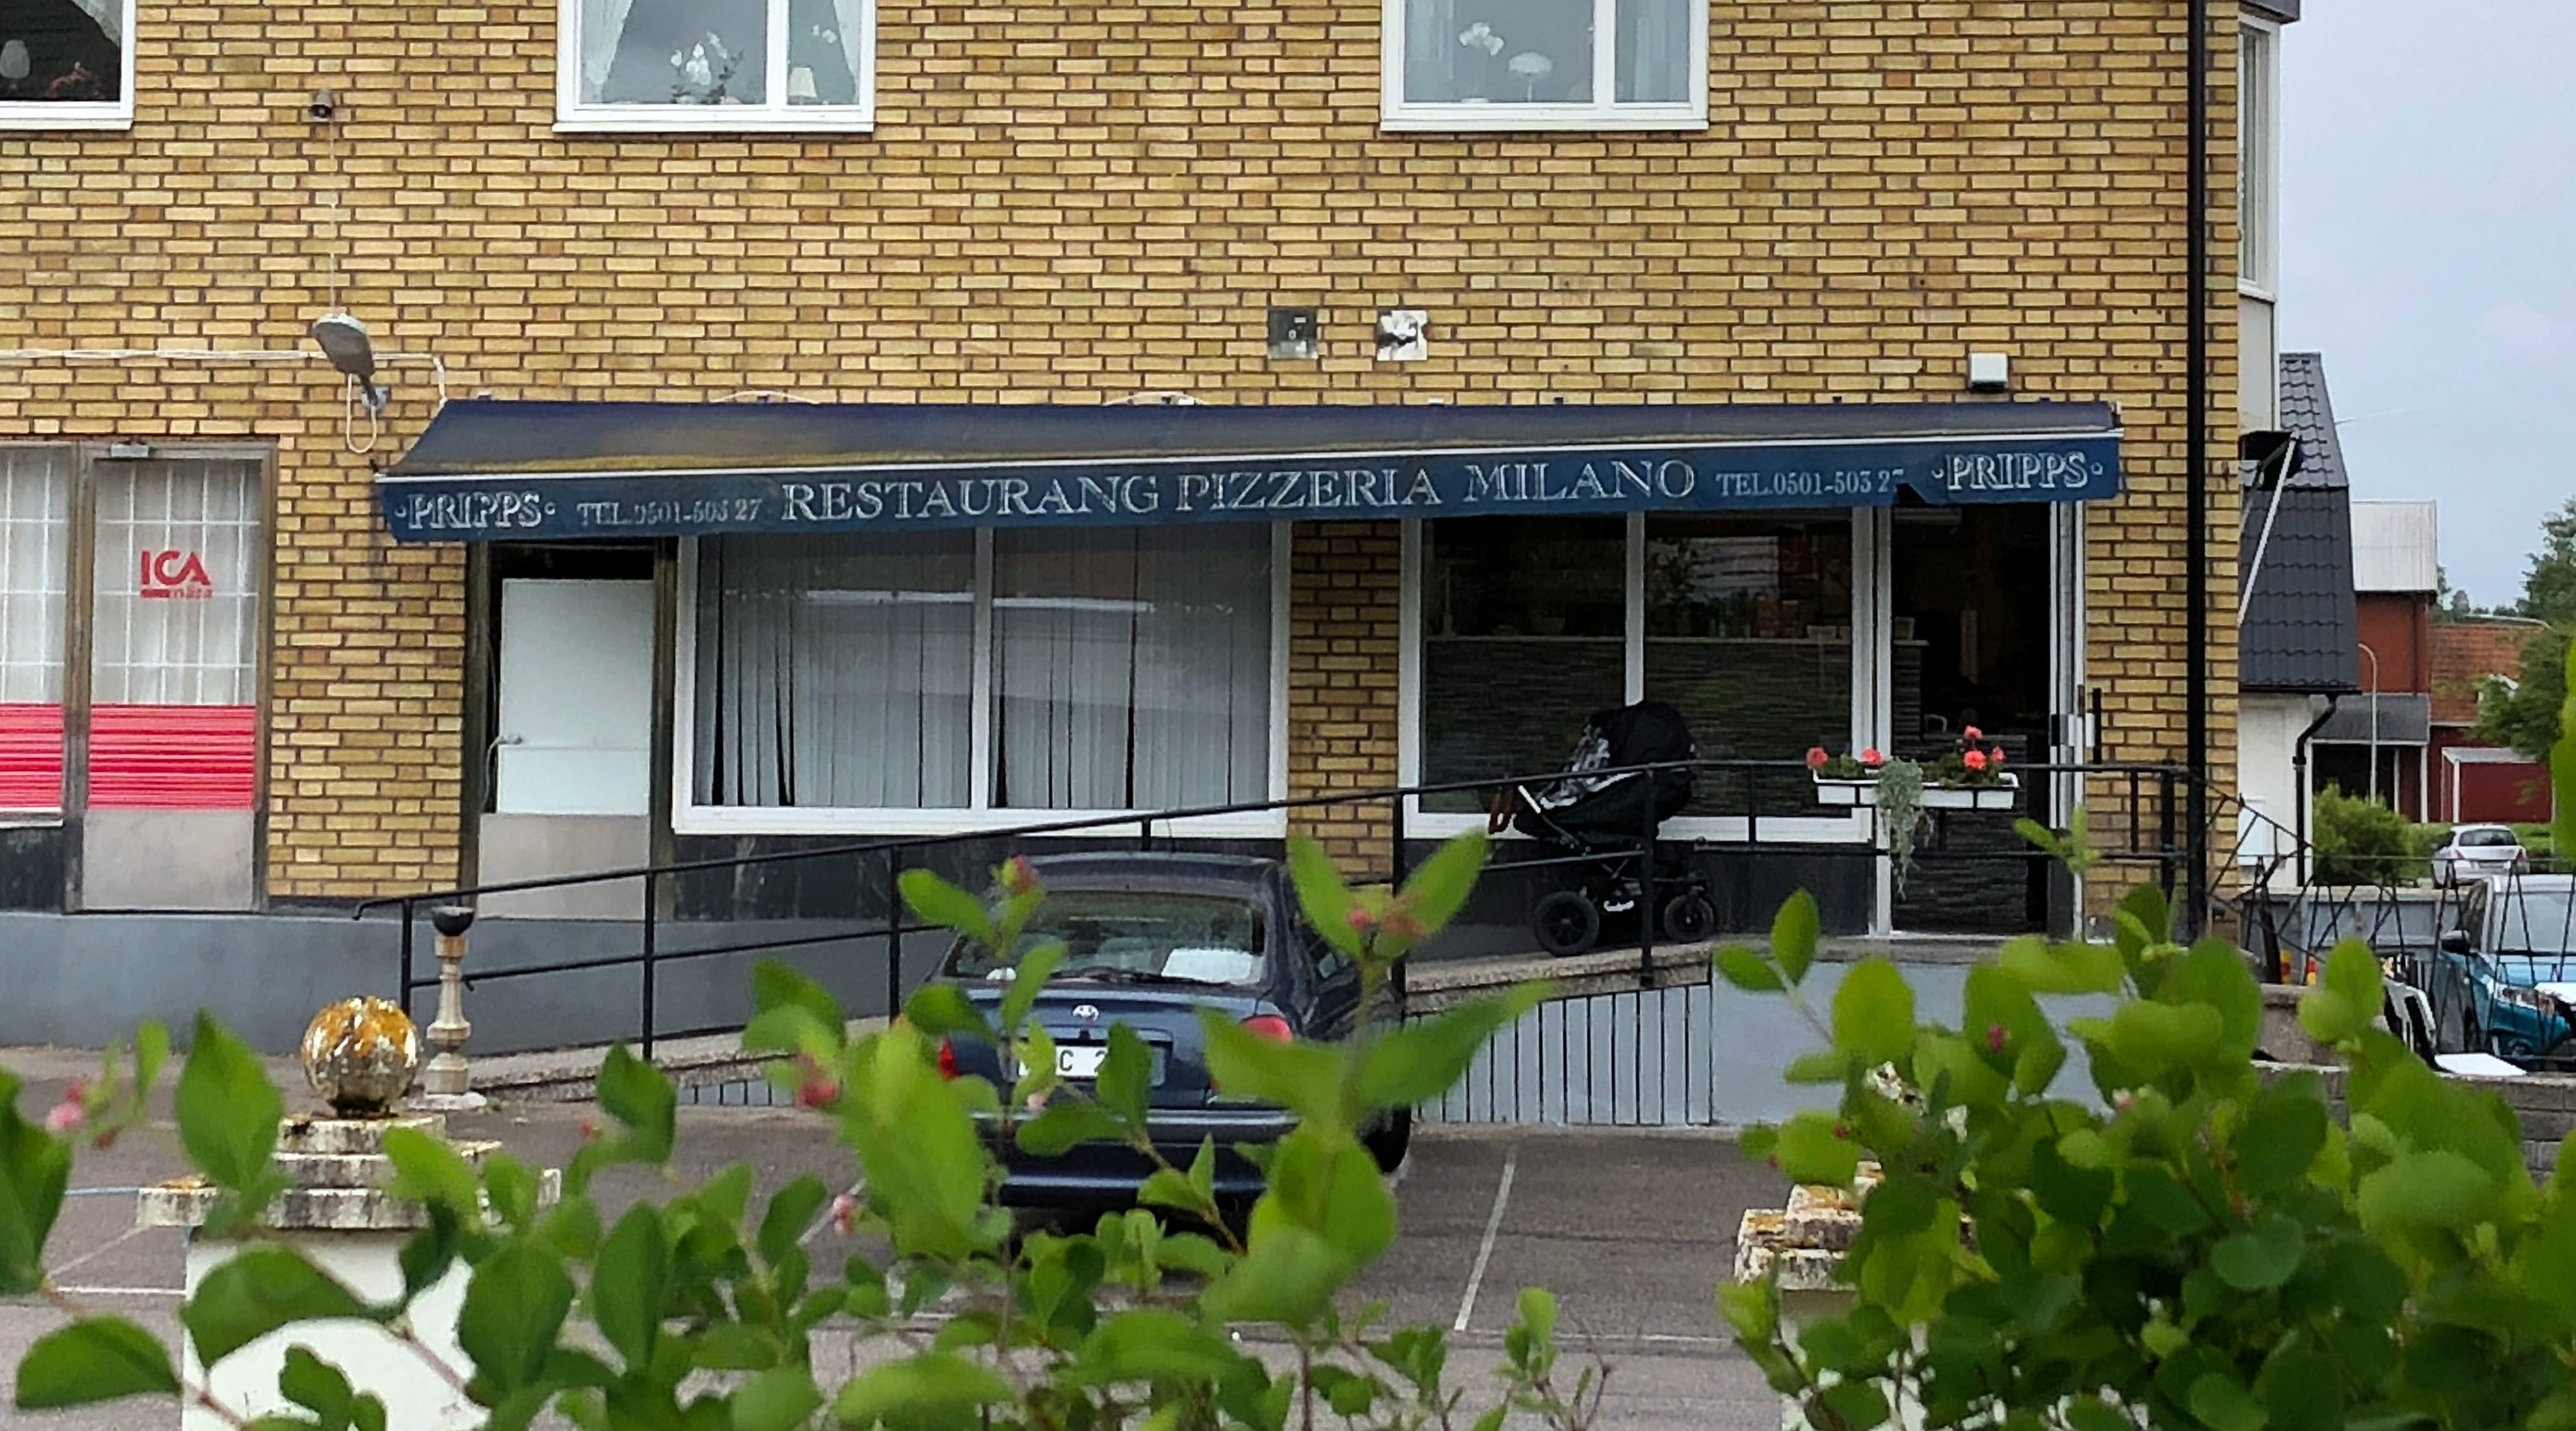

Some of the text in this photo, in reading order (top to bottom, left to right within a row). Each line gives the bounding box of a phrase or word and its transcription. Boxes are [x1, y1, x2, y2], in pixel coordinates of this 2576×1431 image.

[781, 460, 1695, 520] RESTAURANG PIZZERIA MILANO
[1947, 452, 2088, 492] PRIPPS
[407, 491, 541, 529] PRIPPS
[735, 498, 762, 521] 27
[141, 551, 211, 586] ICA
